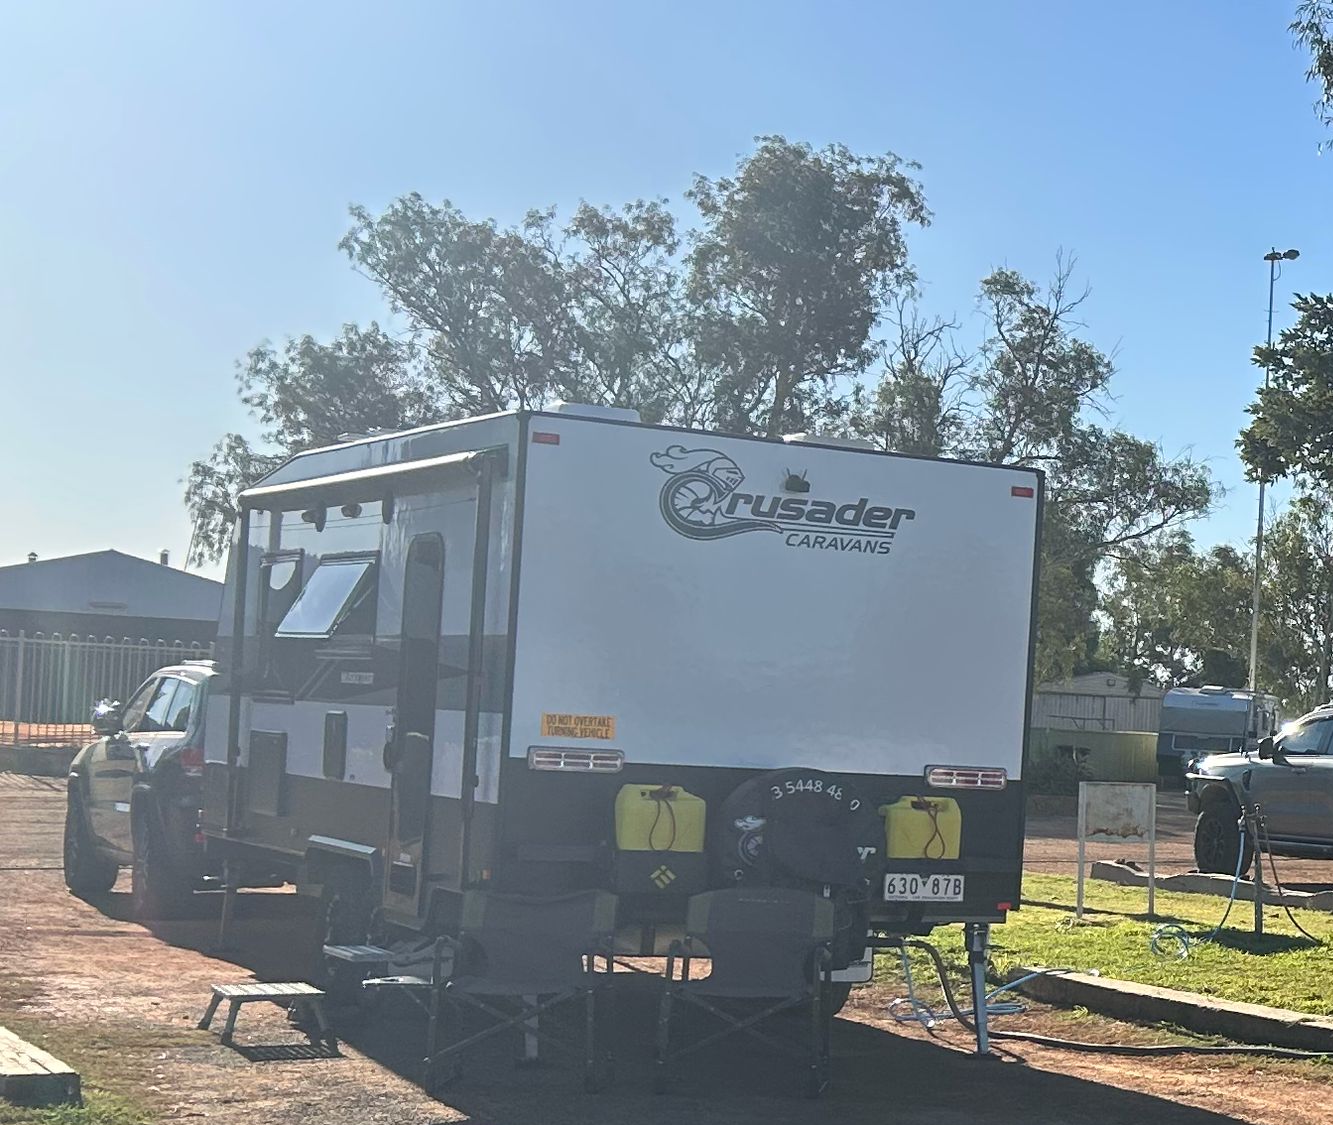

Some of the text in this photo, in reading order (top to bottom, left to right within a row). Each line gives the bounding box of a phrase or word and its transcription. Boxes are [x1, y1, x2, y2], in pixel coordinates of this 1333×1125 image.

[785, 533, 893, 555] CARAVANS
[574, 715, 611, 727] OVERTAKE
[785, 779, 823, 794] 5448
[887, 877, 962, 896] 630 87B
